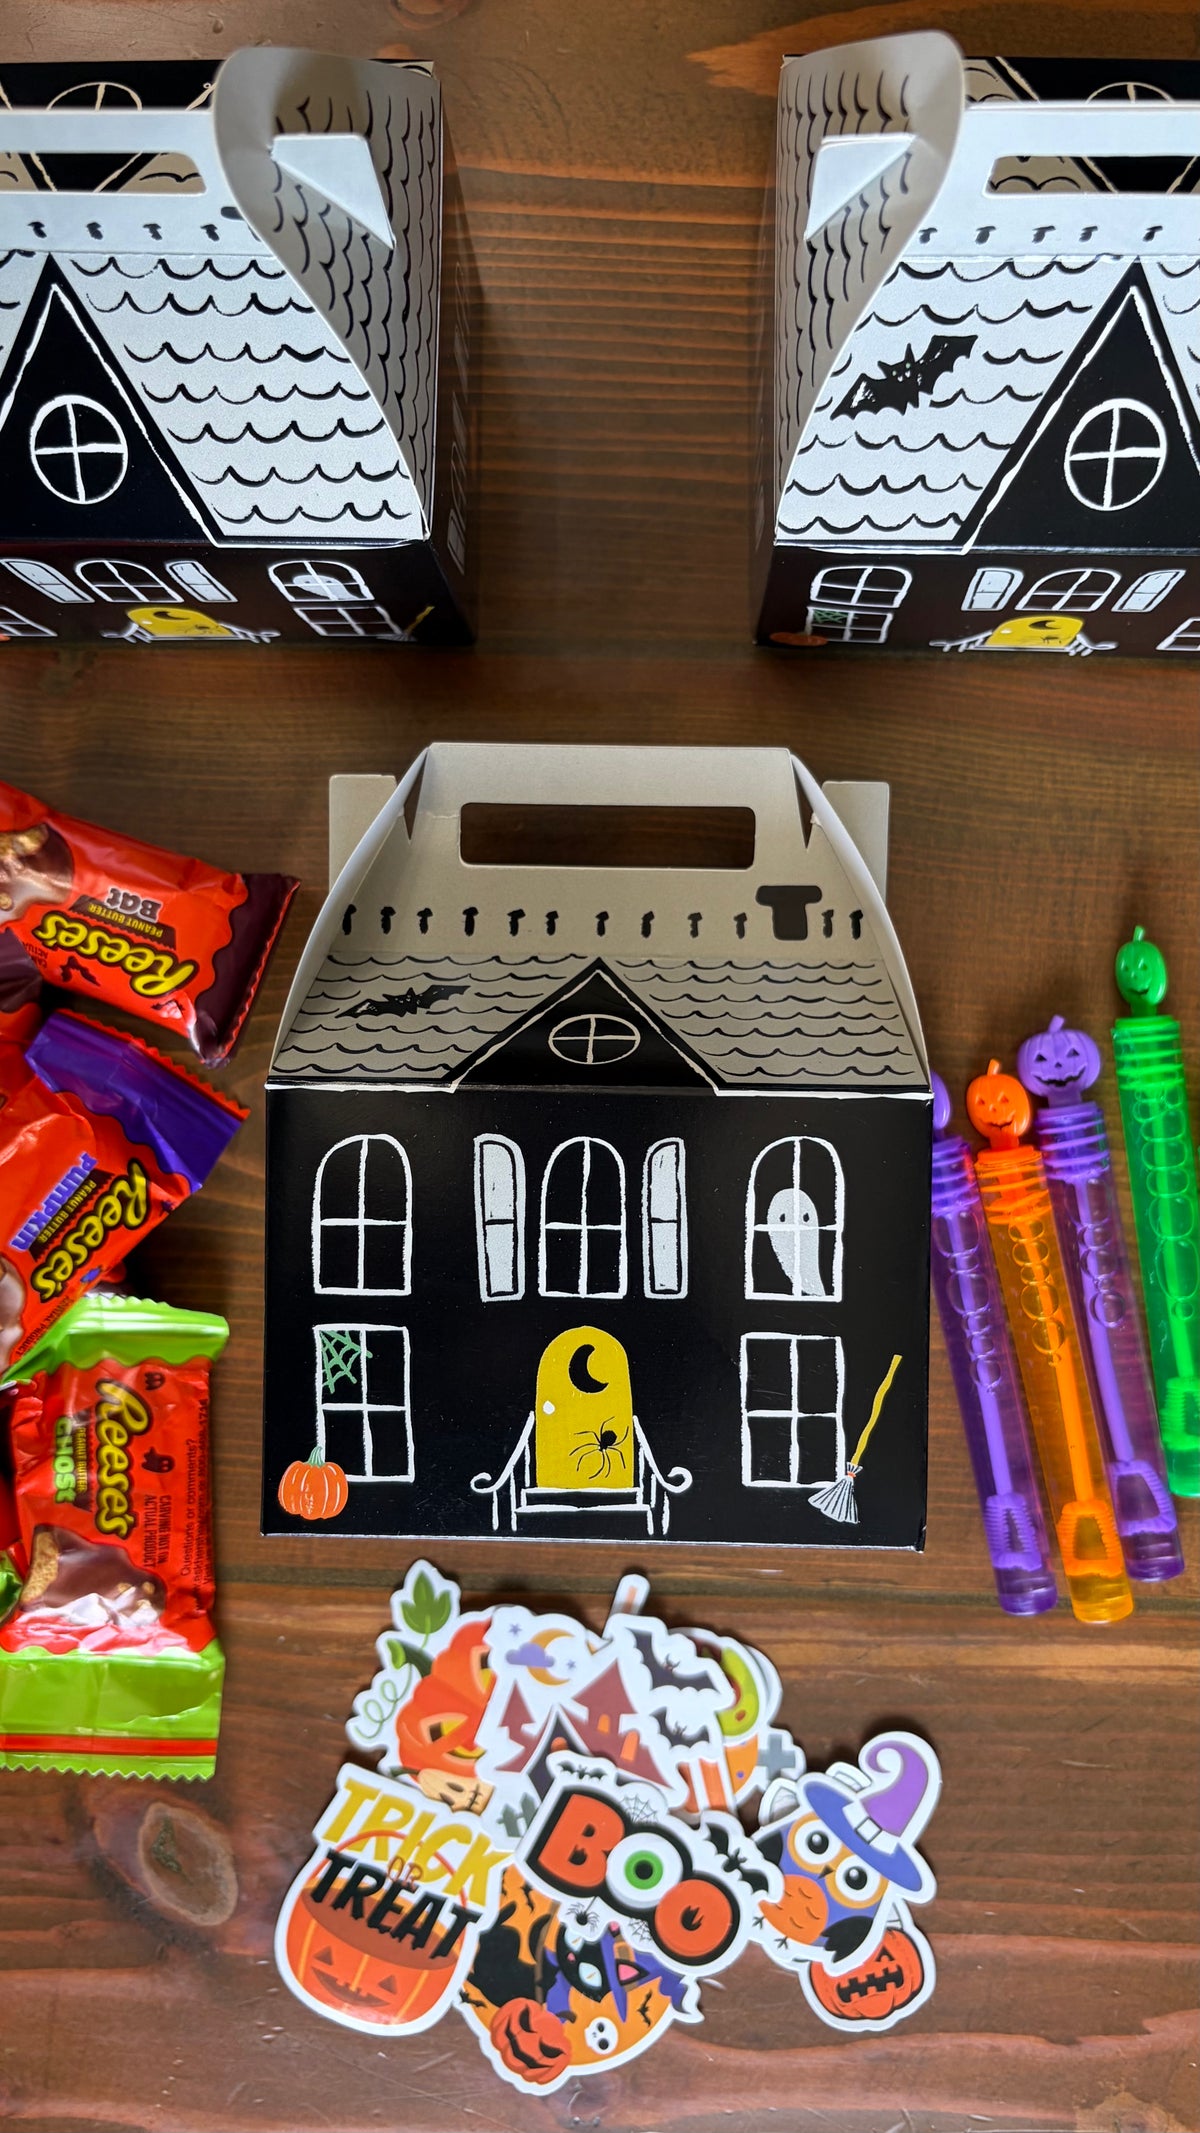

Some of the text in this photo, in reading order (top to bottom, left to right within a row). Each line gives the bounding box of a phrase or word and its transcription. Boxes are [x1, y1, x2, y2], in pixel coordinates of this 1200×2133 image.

[34, 913, 196, 997] Reese's
[88, 903, 163, 937] PEANUT BUTTER
[32, 1160, 149, 1301] Reese's
[39, 1180, 97, 1243] PEANUT BUTTER
[96, 1379, 150, 1538] Reese's
[143, 1494, 157, 1568] ACTUAL PRODUCT
[180, 1521, 194, 1576] Questions
[185, 1507, 195, 1518] or
[323, 1778, 514, 1907] TRICK
[387, 1856, 423, 1891] OR
[530, 1788, 738, 1965] BOO
[311, 1849, 483, 1963] TREAT
